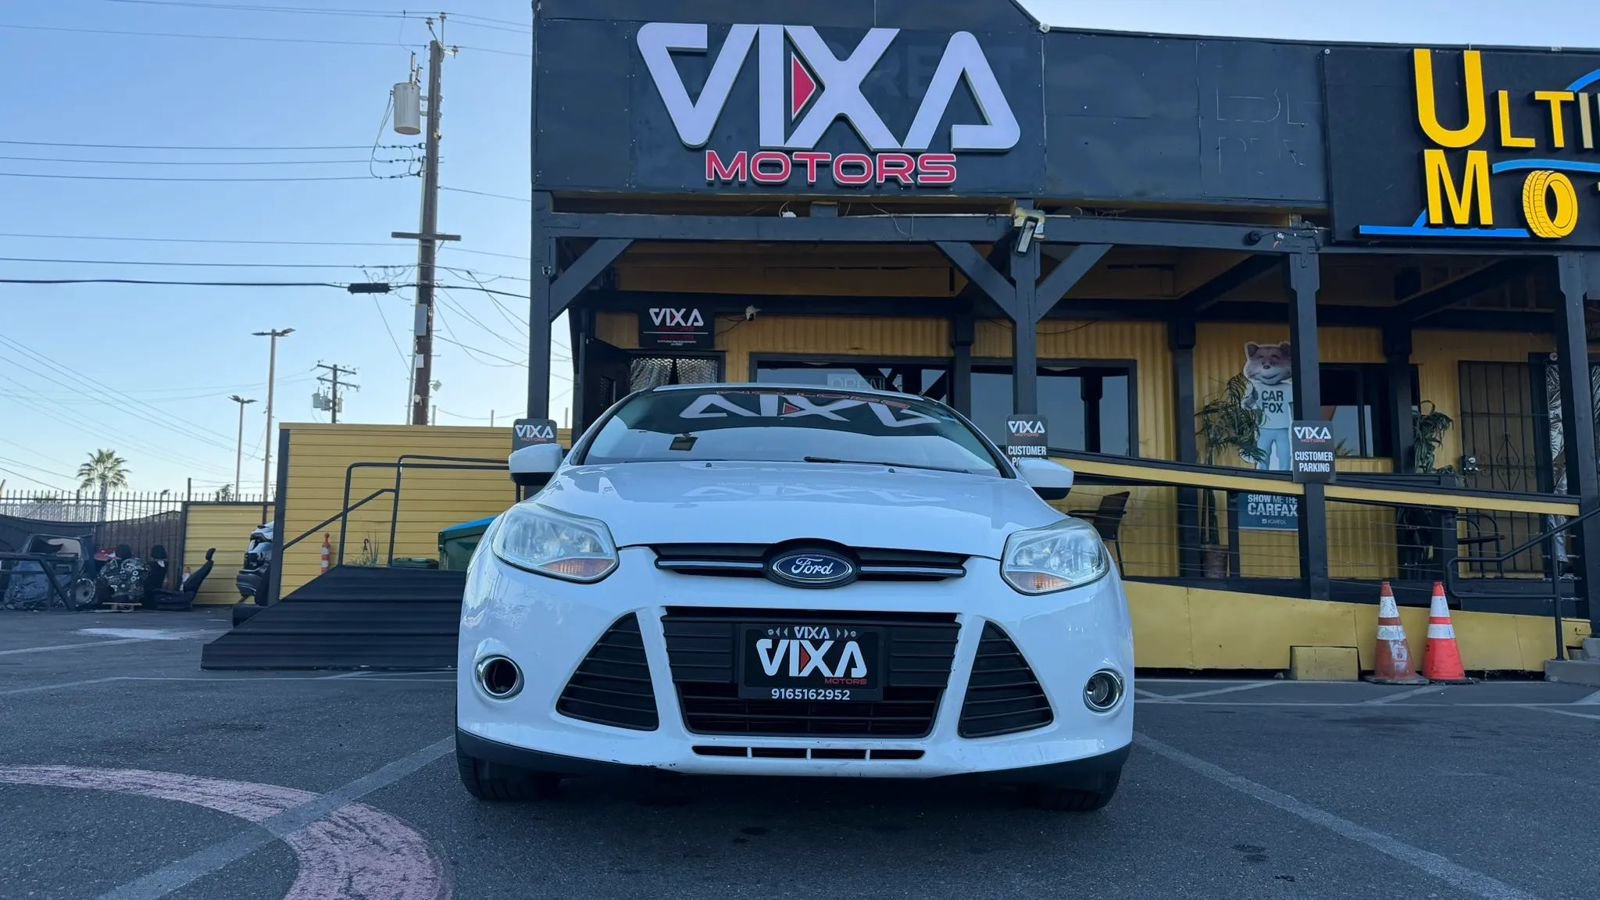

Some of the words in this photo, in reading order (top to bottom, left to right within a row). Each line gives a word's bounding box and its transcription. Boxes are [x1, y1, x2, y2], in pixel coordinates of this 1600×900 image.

[637, 22, 1021, 152] VIXA
[1414, 48, 1600, 148] ULTI
[705, 150, 957, 186] MOTORS
[649, 308, 704, 326] VIXA
[1261, 390, 1284, 401] CAR
[1262, 402, 1284, 413] FOX
[515, 425, 554, 438] VIXA
[1008, 421, 1046, 433] VIXA
[1294, 426, 1332, 439] VIXA
[1008, 446, 1047, 456] CUSTOMER
[1295, 451, 1333, 461] CUSTOMER
[1299, 462, 1330, 472] PARKING
[1248, 494, 1271, 503] SHOW
[1273, 495, 1284, 503] ME
[1248, 503, 1298, 516] CARFAX
[791, 557, 834, 575] Ford
[794, 626, 829, 639] VIXA
[756, 639, 867, 678] VIXA
[771, 688, 850, 700] 9165162952
